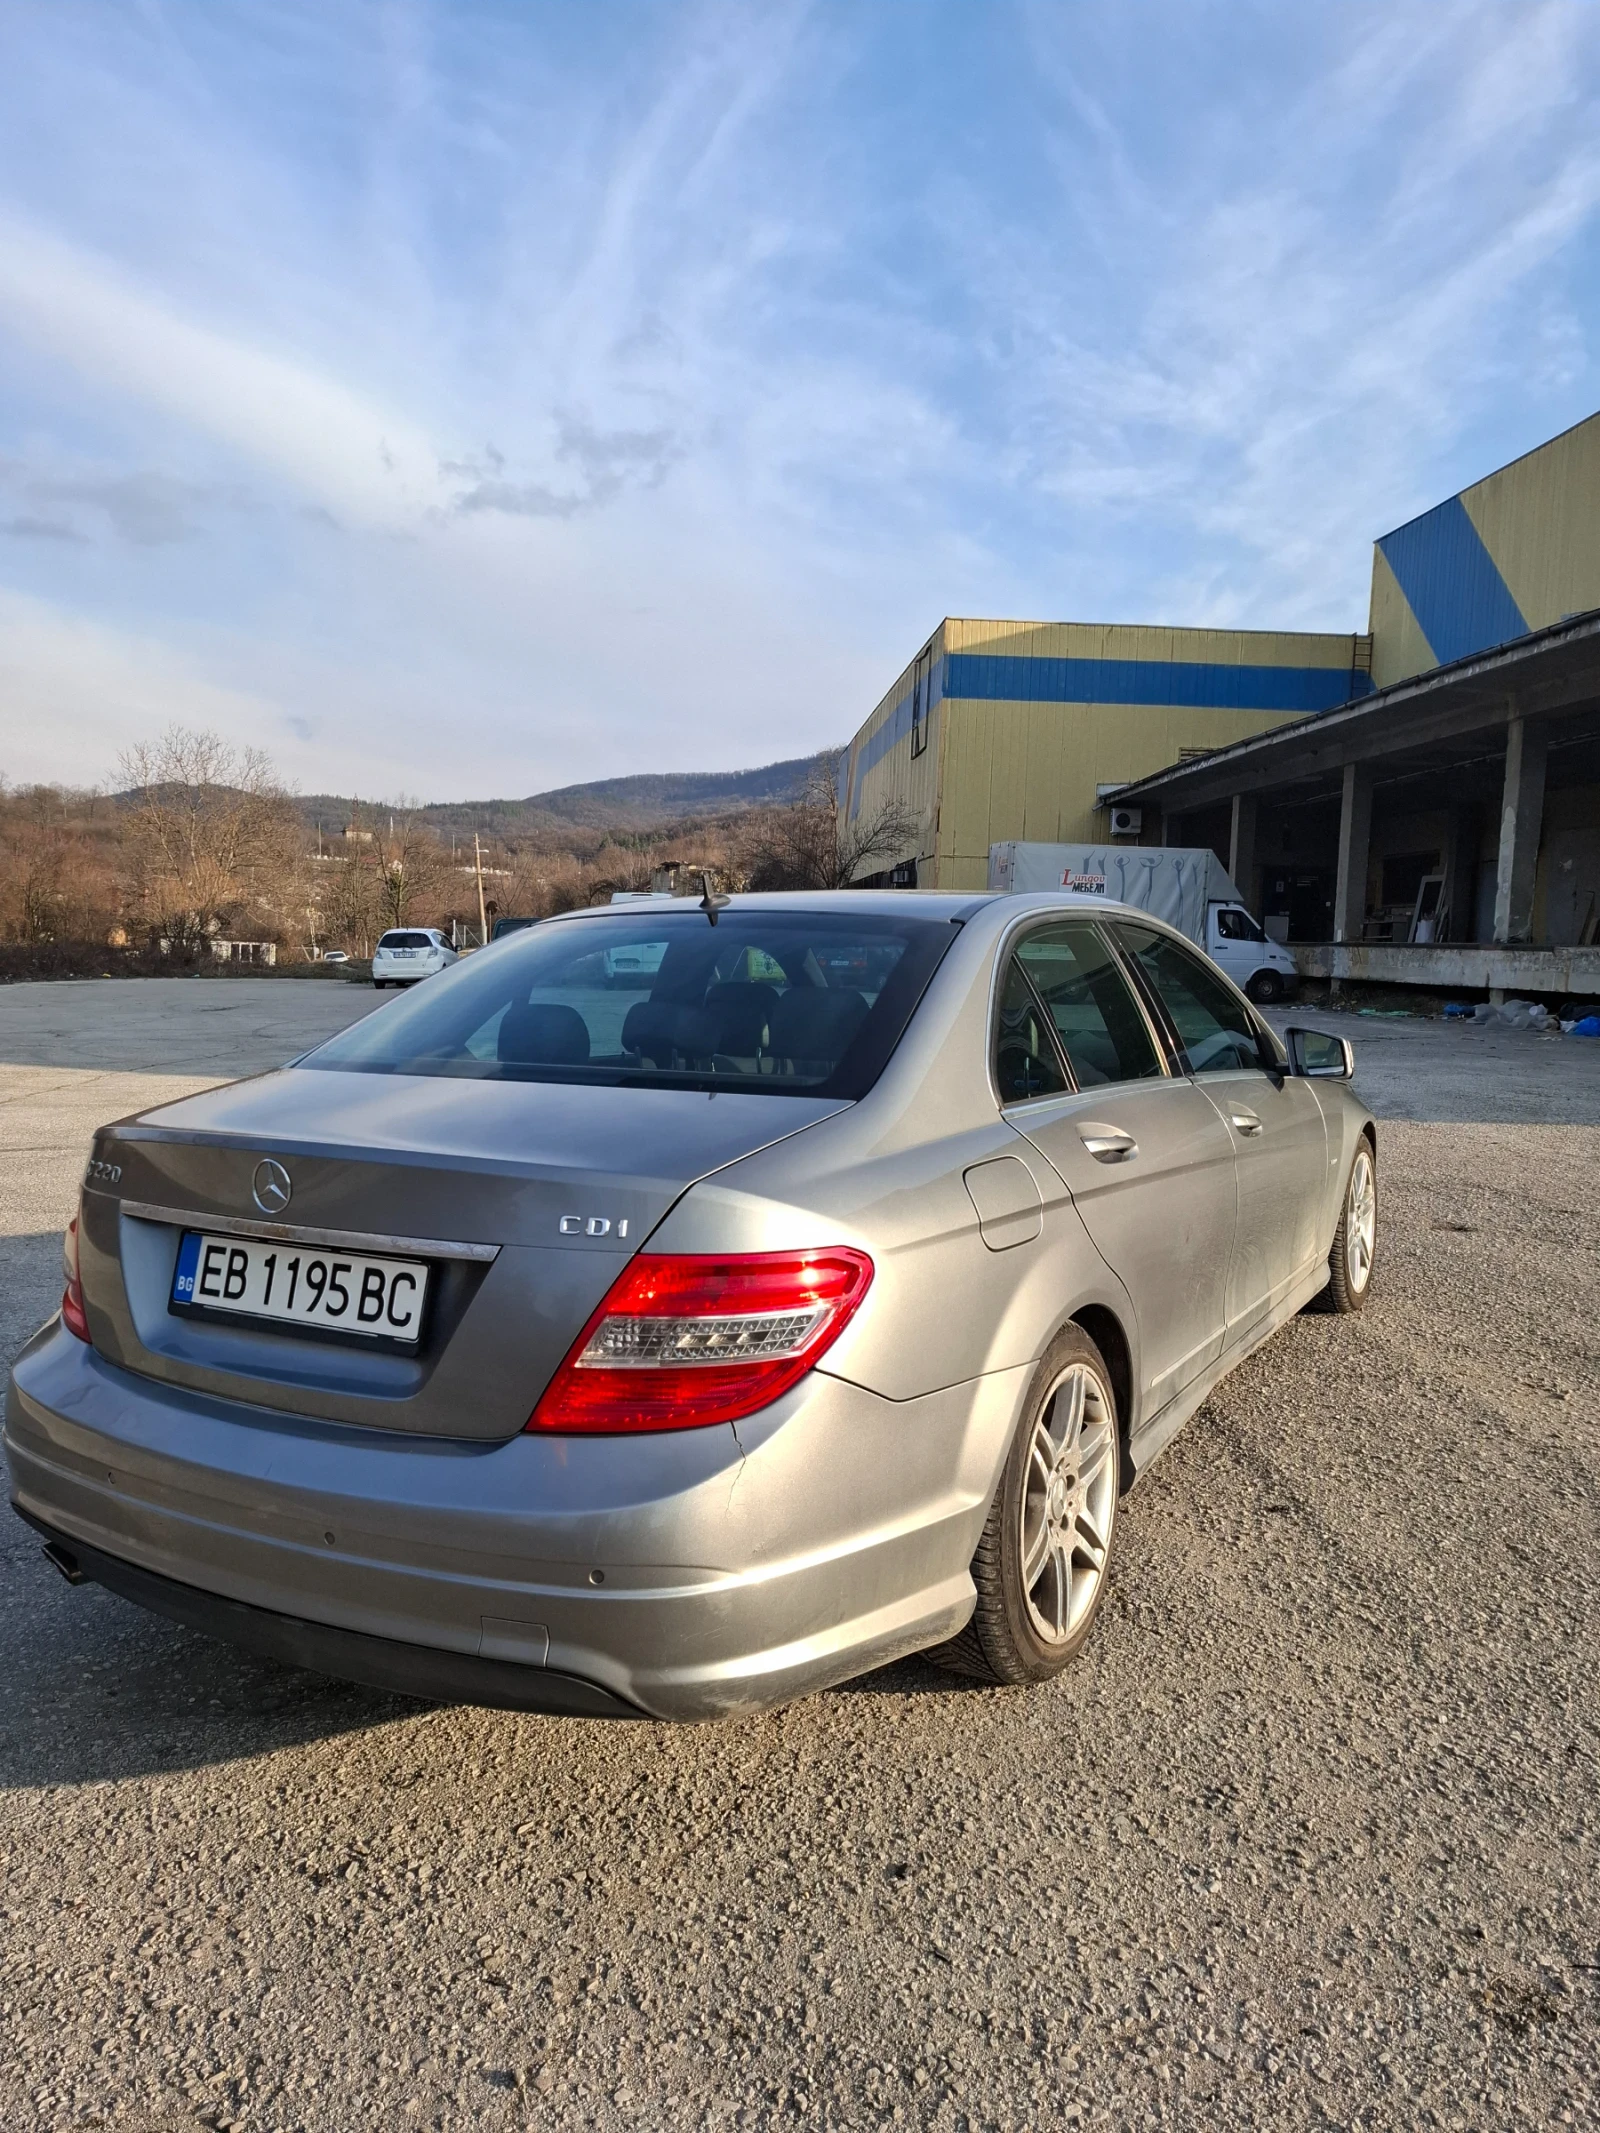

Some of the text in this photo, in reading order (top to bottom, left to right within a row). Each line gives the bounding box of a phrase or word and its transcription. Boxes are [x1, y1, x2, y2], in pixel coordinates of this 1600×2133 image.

[559, 1215, 628, 1238] CDI
[177, 1275, 194, 1292] BG
[199, 1244, 417, 1328] EB 1195 BC
